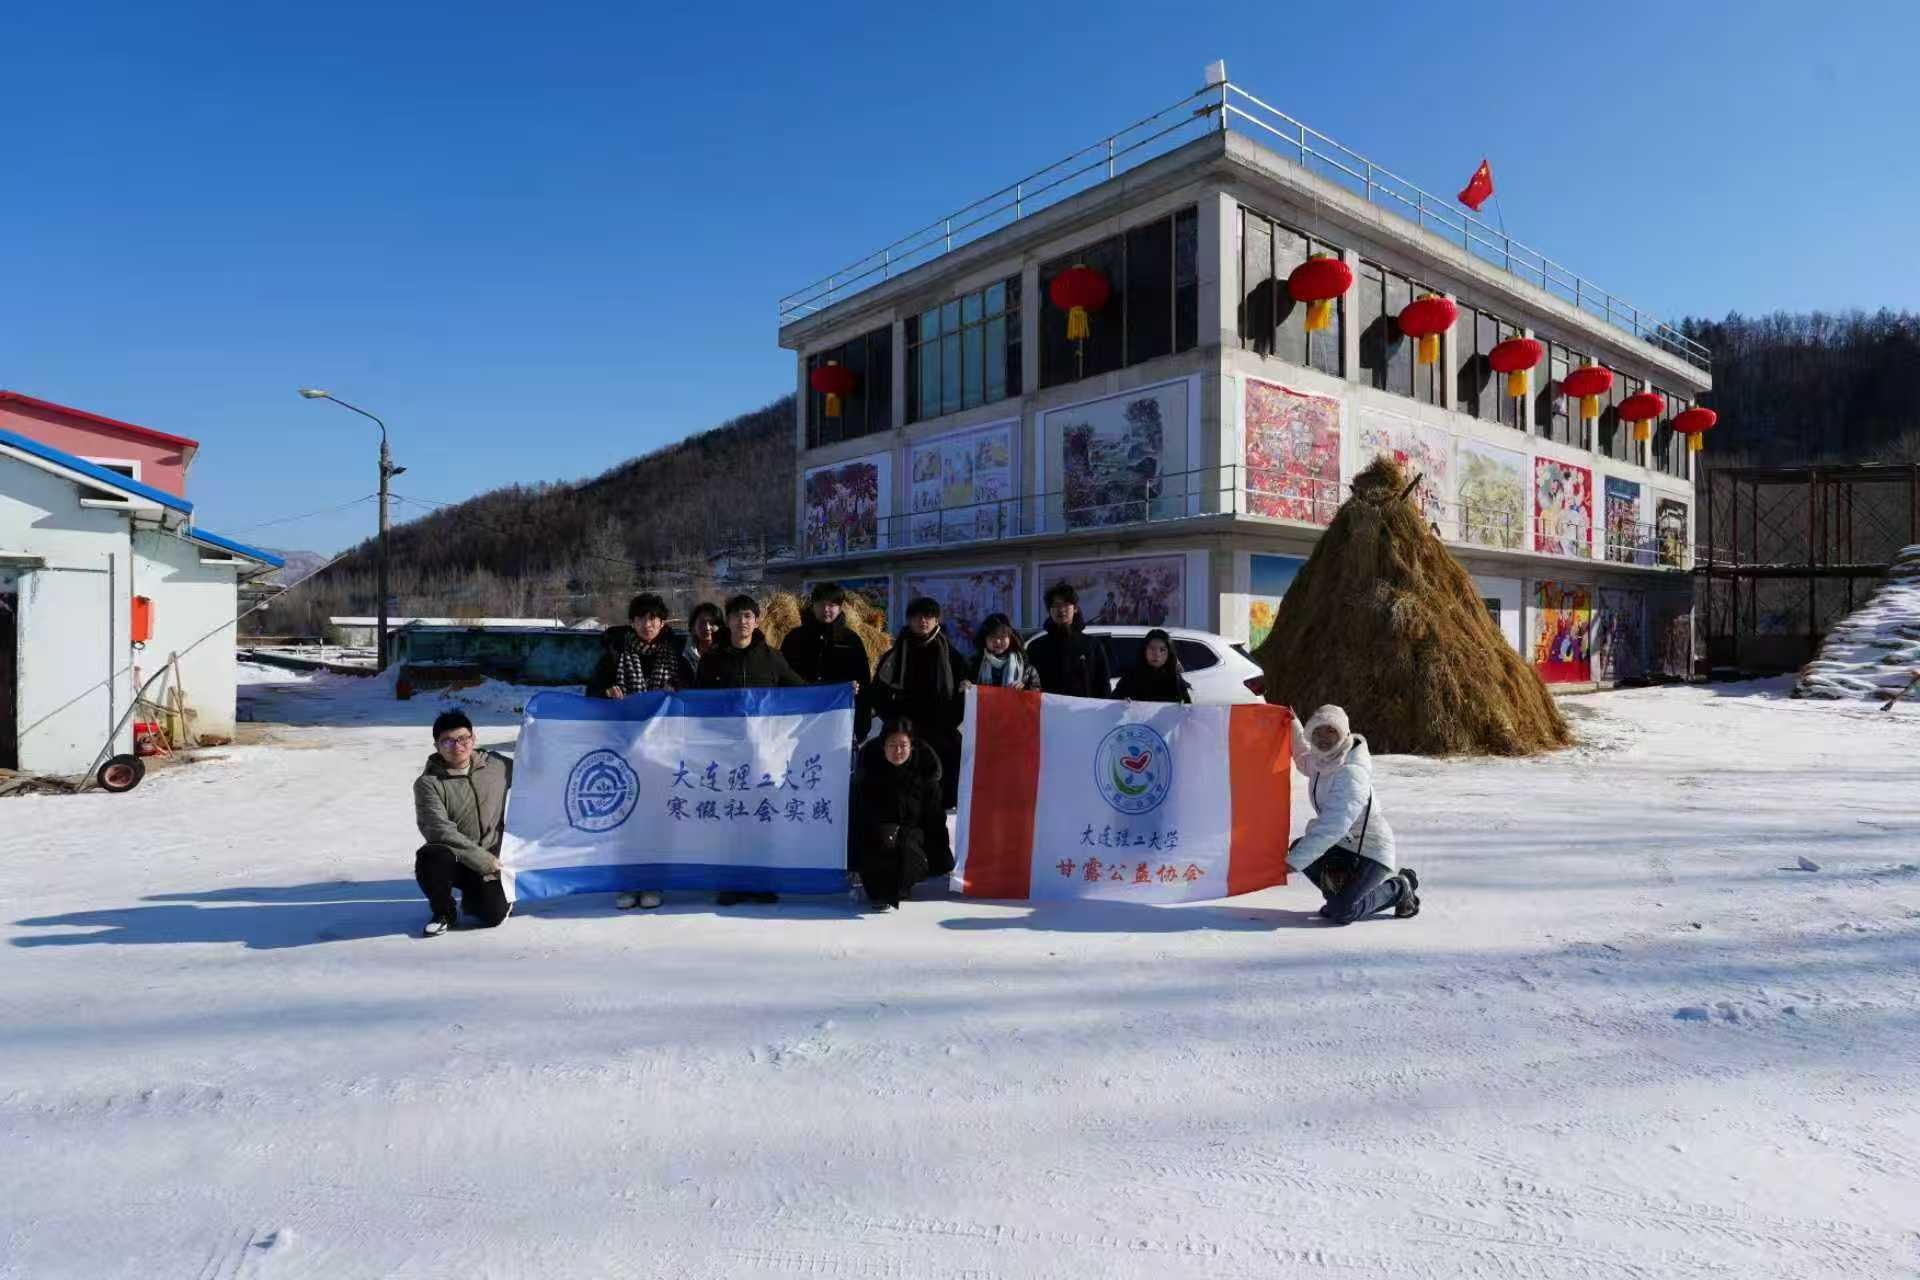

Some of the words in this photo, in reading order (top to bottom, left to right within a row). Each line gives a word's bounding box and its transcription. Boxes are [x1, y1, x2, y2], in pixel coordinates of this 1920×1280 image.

[671, 753, 823, 792] 大连理工大学
[666, 796, 833, 825] 寒假社会实践
[1080, 823, 1179, 851] 大连理工大学
[1056, 855, 1206, 883] 甘露公益协会
